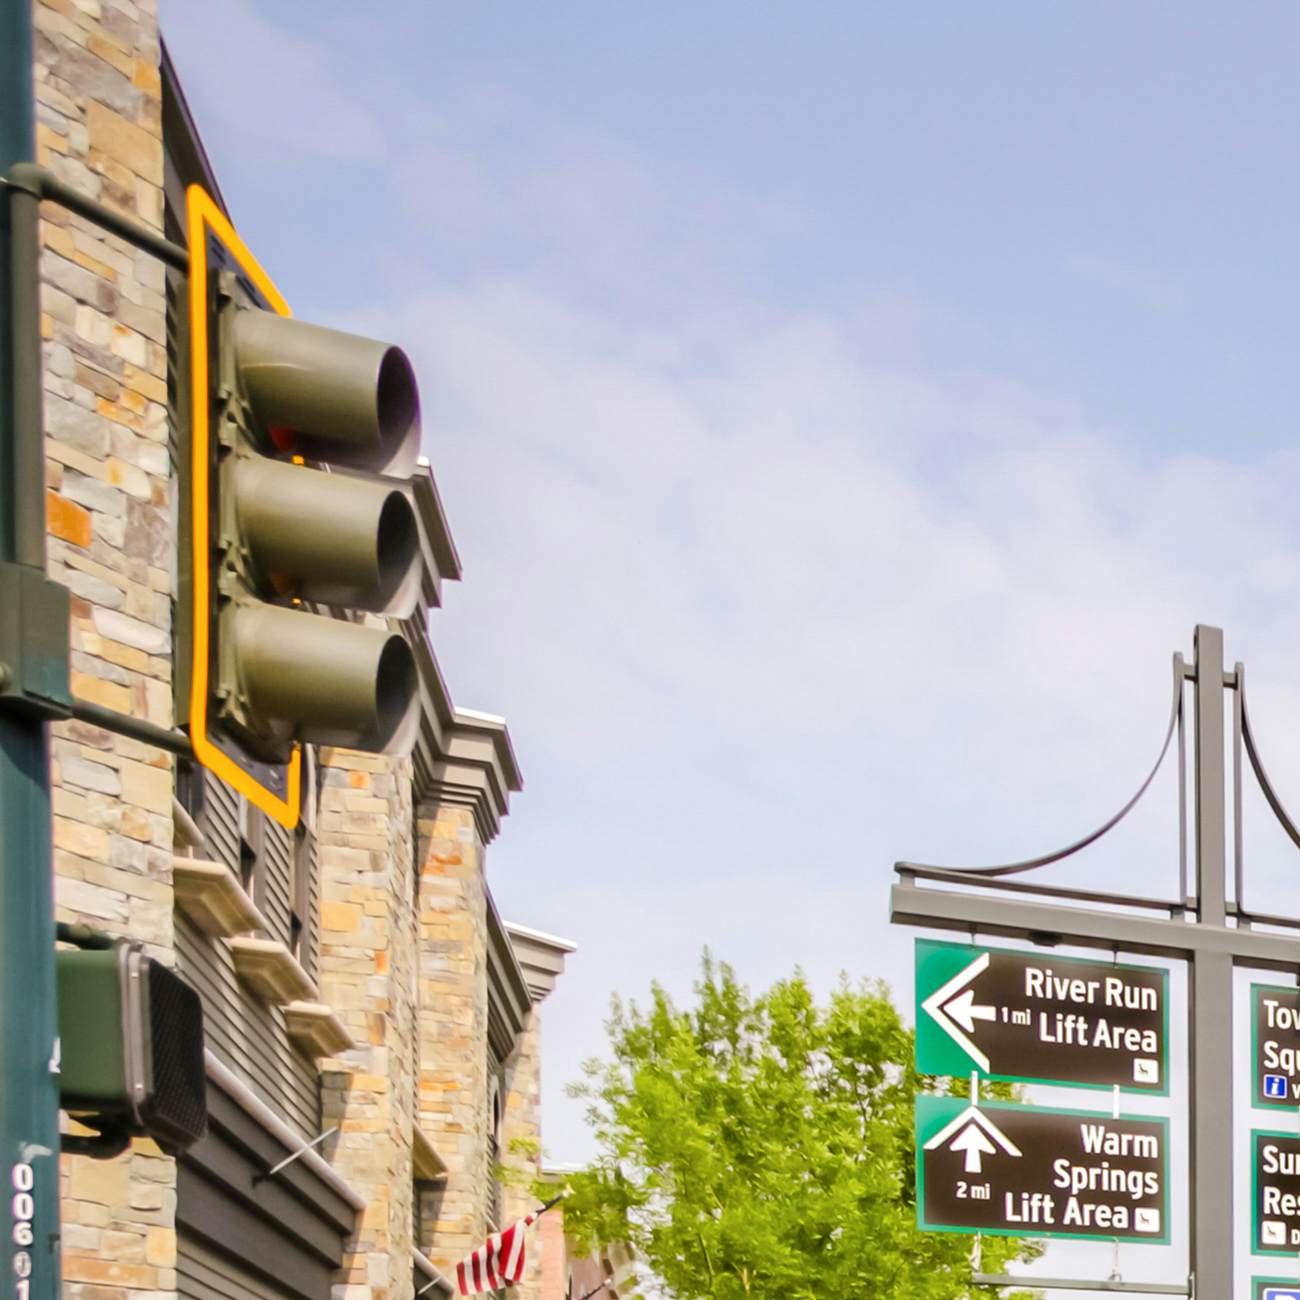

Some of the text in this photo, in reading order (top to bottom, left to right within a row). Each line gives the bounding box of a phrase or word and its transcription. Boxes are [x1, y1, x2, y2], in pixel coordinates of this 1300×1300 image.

[1025, 967, 1158, 1011] River Run
[1001, 1007, 1031, 1026] 1 mi
[1039, 1012, 1158, 1053] Lift Area
[1080, 1123, 1159, 1158] Warm
[956, 1181, 991, 1200] 2 mi
[1053, 1158, 1159, 1200] Springs
[1005, 1191, 1129, 1229] Lift Area
